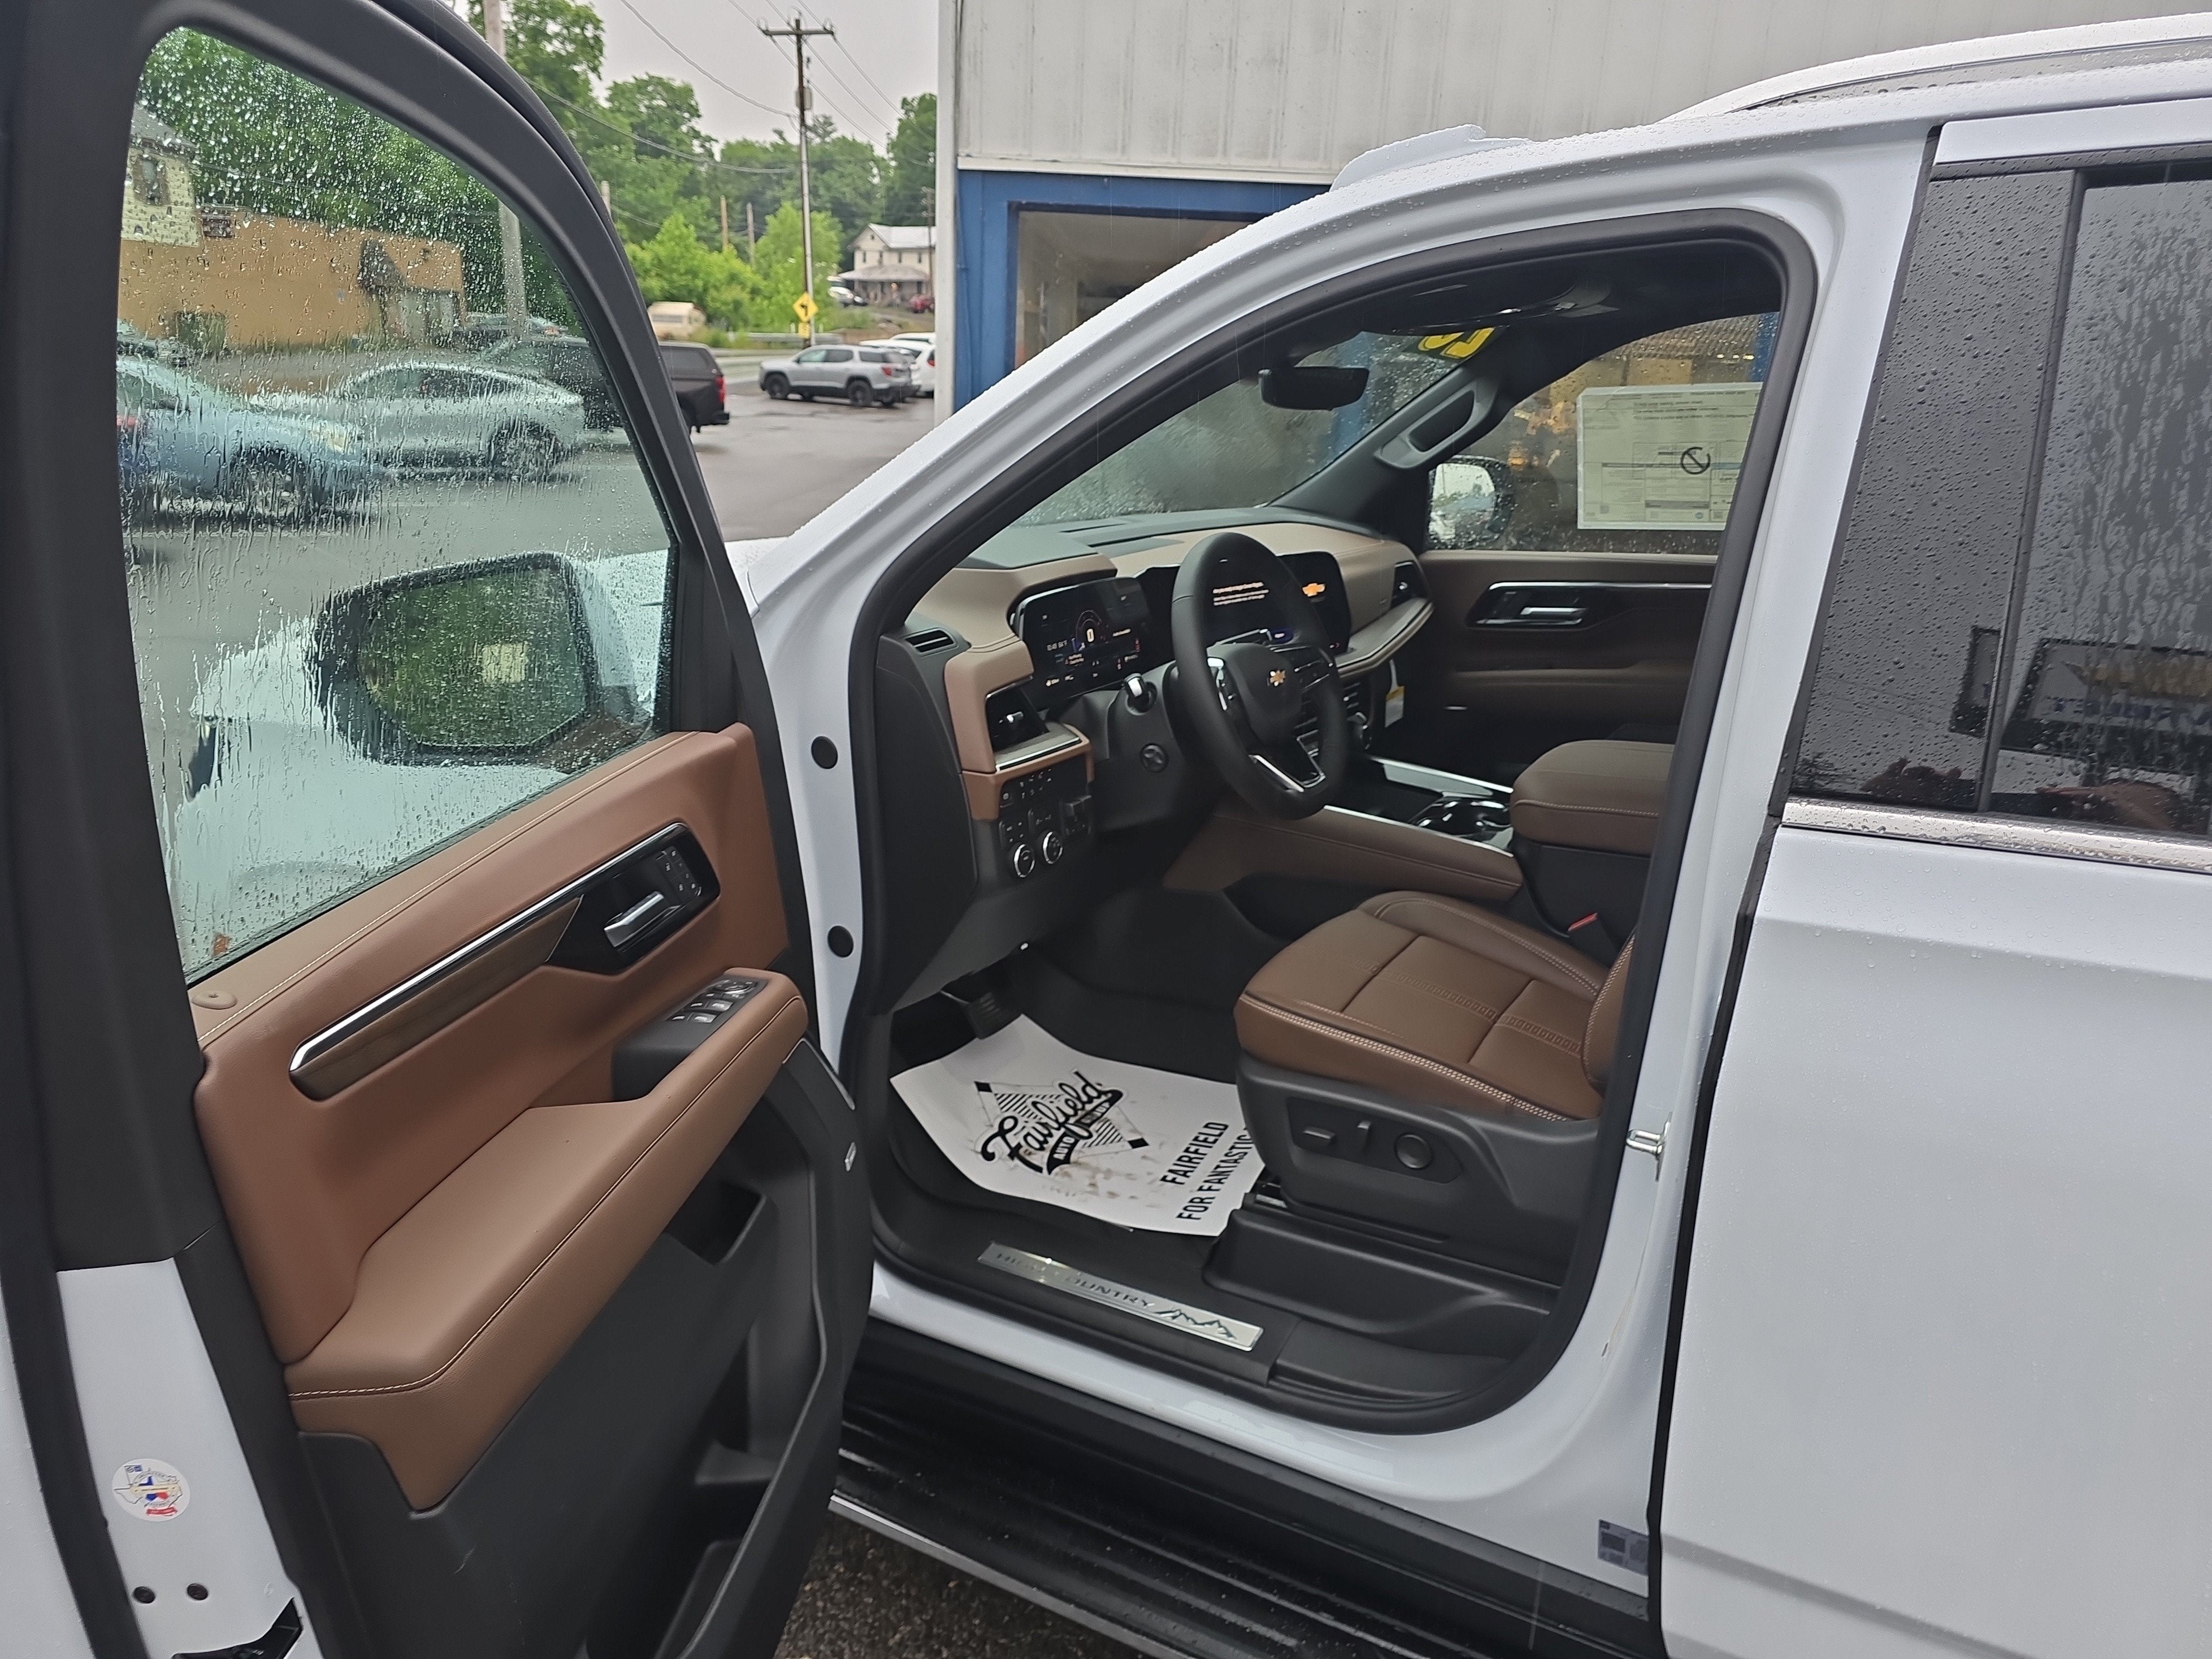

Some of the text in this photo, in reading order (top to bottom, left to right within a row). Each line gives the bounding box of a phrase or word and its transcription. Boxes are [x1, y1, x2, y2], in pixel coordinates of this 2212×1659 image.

[981, 1070, 1117, 1174] Fairfield
[1053, 1136, 1075, 1160] AUTO
[1160, 1121, 1229, 1185] FAIRFIELD
[1175, 1134, 1254, 1220] FOR FANTASTIC
